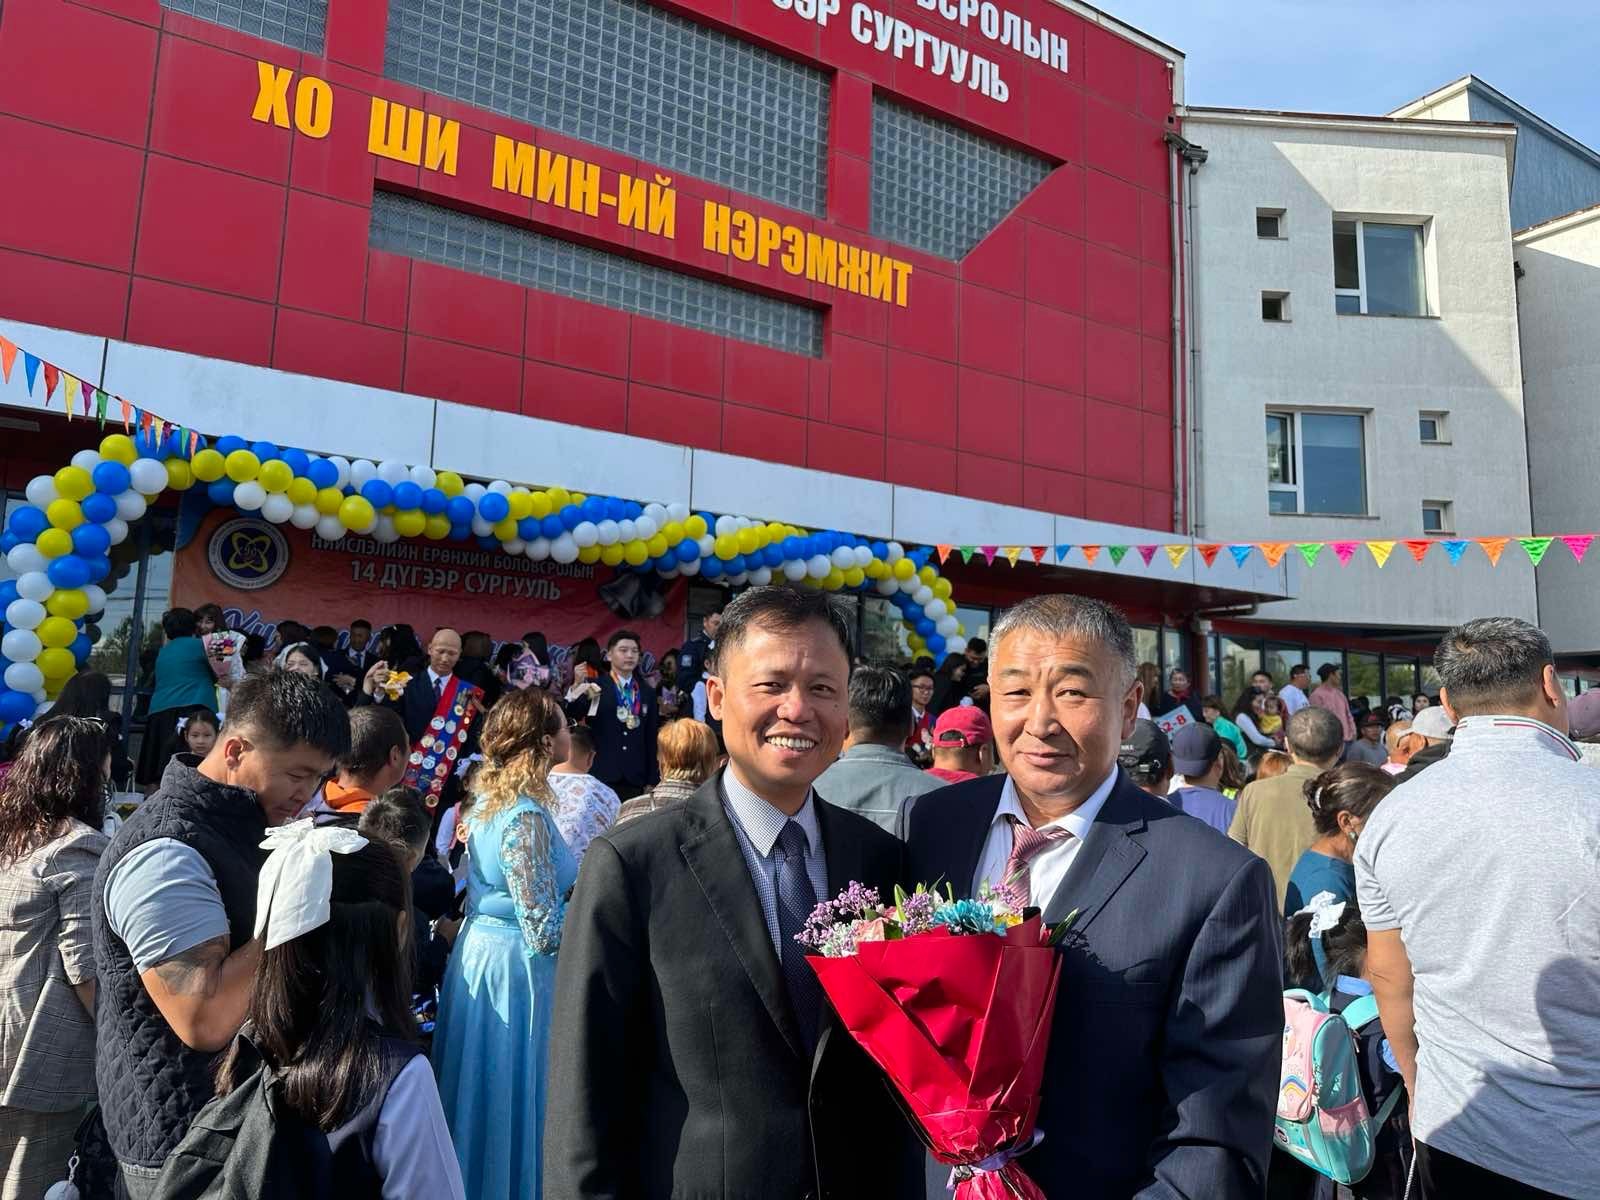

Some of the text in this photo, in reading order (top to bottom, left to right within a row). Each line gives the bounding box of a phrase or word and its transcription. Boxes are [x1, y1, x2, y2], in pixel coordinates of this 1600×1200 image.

[851, 1, 1009, 103] СУРГУУЛЬ
[917, 0, 1068, 74] СРОЛЫН
[251, 60, 913, 308] ХО ШИ МИН-ИЙ НЭРЭМЖИТ
[351, 560, 375, 582] 14
[464, 571, 561, 600] СУРГУУЛЬ
